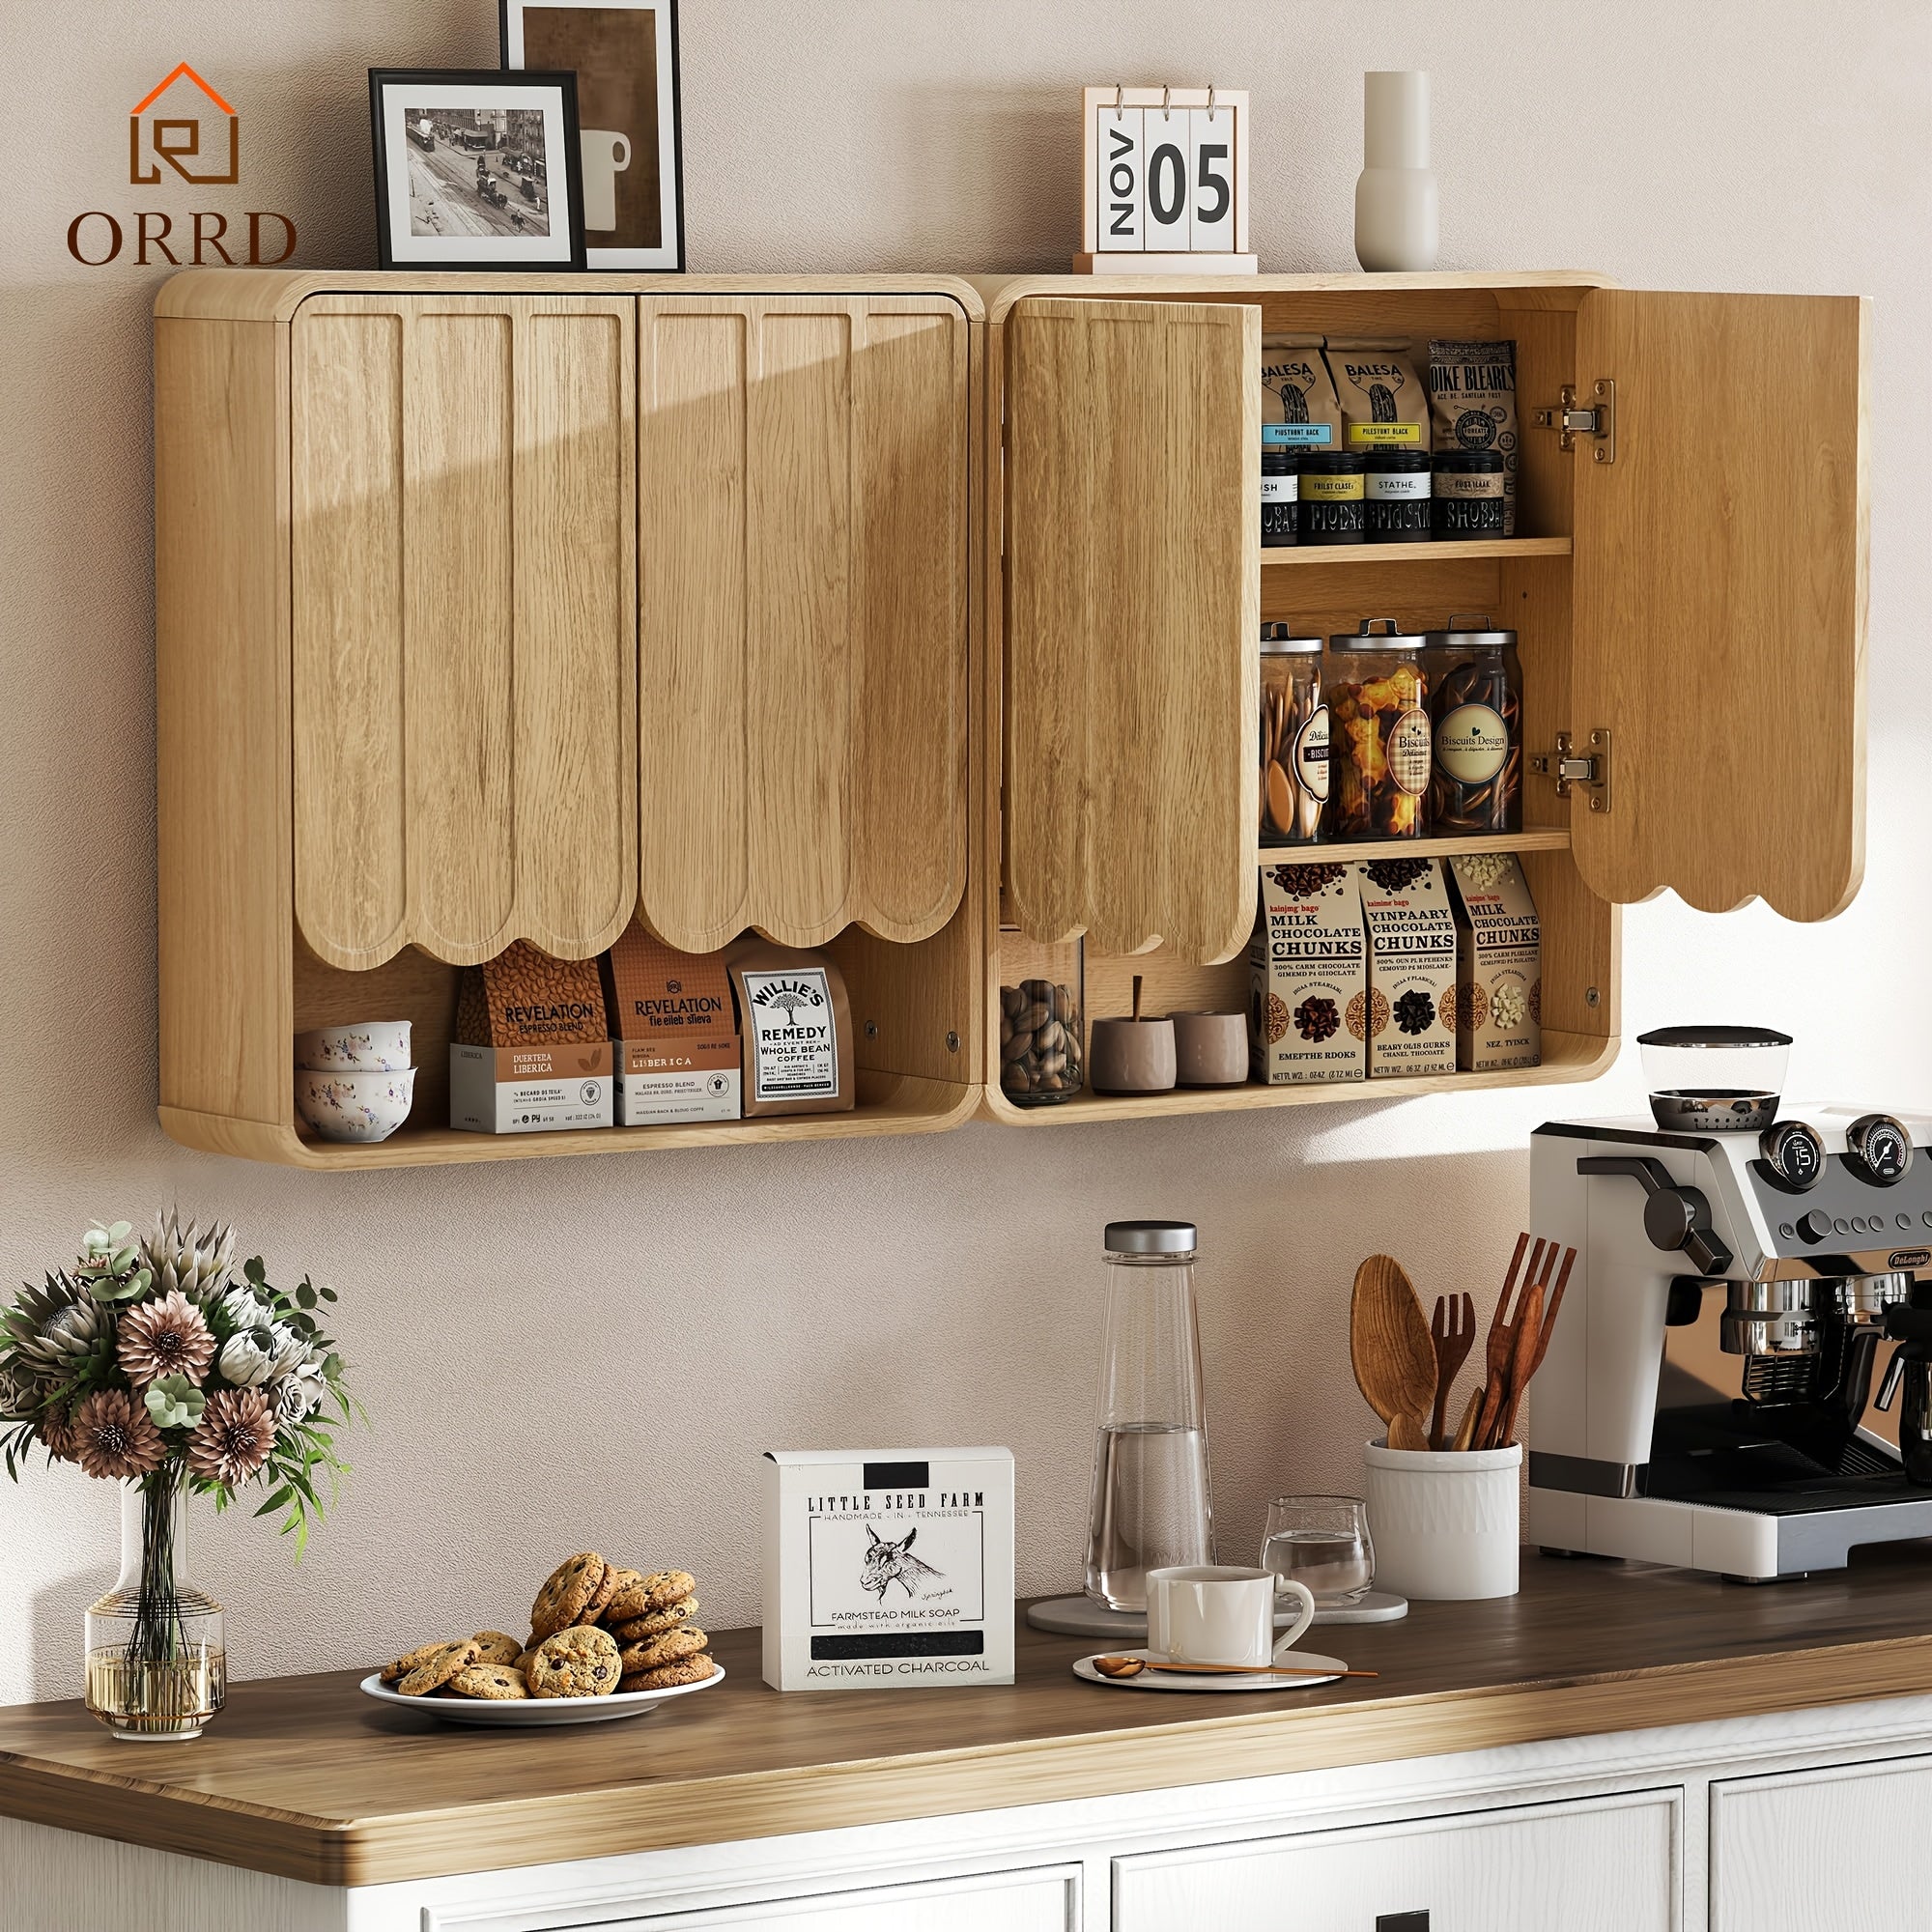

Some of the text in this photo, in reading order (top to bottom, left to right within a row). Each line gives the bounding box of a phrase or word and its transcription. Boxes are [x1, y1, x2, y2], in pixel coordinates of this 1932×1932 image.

[1110, 128, 1134, 235] NOV
[1149, 143, 1230, 224] 05
[1345, 364, 1403, 377] BALESA
[1442, 736, 1504, 747] Biscuits Design
[1369, 909, 1449, 921] YINPAARY
[1469, 904, 1506, 916] MILK
[1270, 915, 1318, 925] MILK
[1474, 916, 1538, 928] CHOCOLATE
[1271, 928, 1361, 938] CHOCOLATE
[1373, 922, 1453, 933] CHOCOLATE
[1374, 934, 1454, 951] CHUNKS
[1476, 928, 1539, 945] CHUNKS
[1272, 941, 1362, 955] CHUNKS
[753, 980, 824, 1008] WILLIE'S
[635, 997, 722, 1016] REVELATION
[505, 1004, 594, 1023] REVELATION
[519, 1022, 583, 1034] ESPRESSO BLEND
[762, 1026, 826, 1041] REMEDY
[760, 1043, 830, 1055] WHOLE BEAN
[514, 1063, 553, 1073] LIBERICA
[1795, 1148, 1811, 1166] 15
[1894, 1255, 1928, 1265] DeLonghi
[808, 1492, 983, 1512] LITTLE SEED FARM
[824, 1513, 882, 1521] HANDMADE
[832, 1608, 960, 1621] FARMSTEAD MILK SOAP
[838, 1621, 864, 1630] made
[869, 1620, 890, 1629] with
[895, 1621, 932, 1630] organic
[807, 1661, 989, 1677] ACTIVATED CHARCOAL
